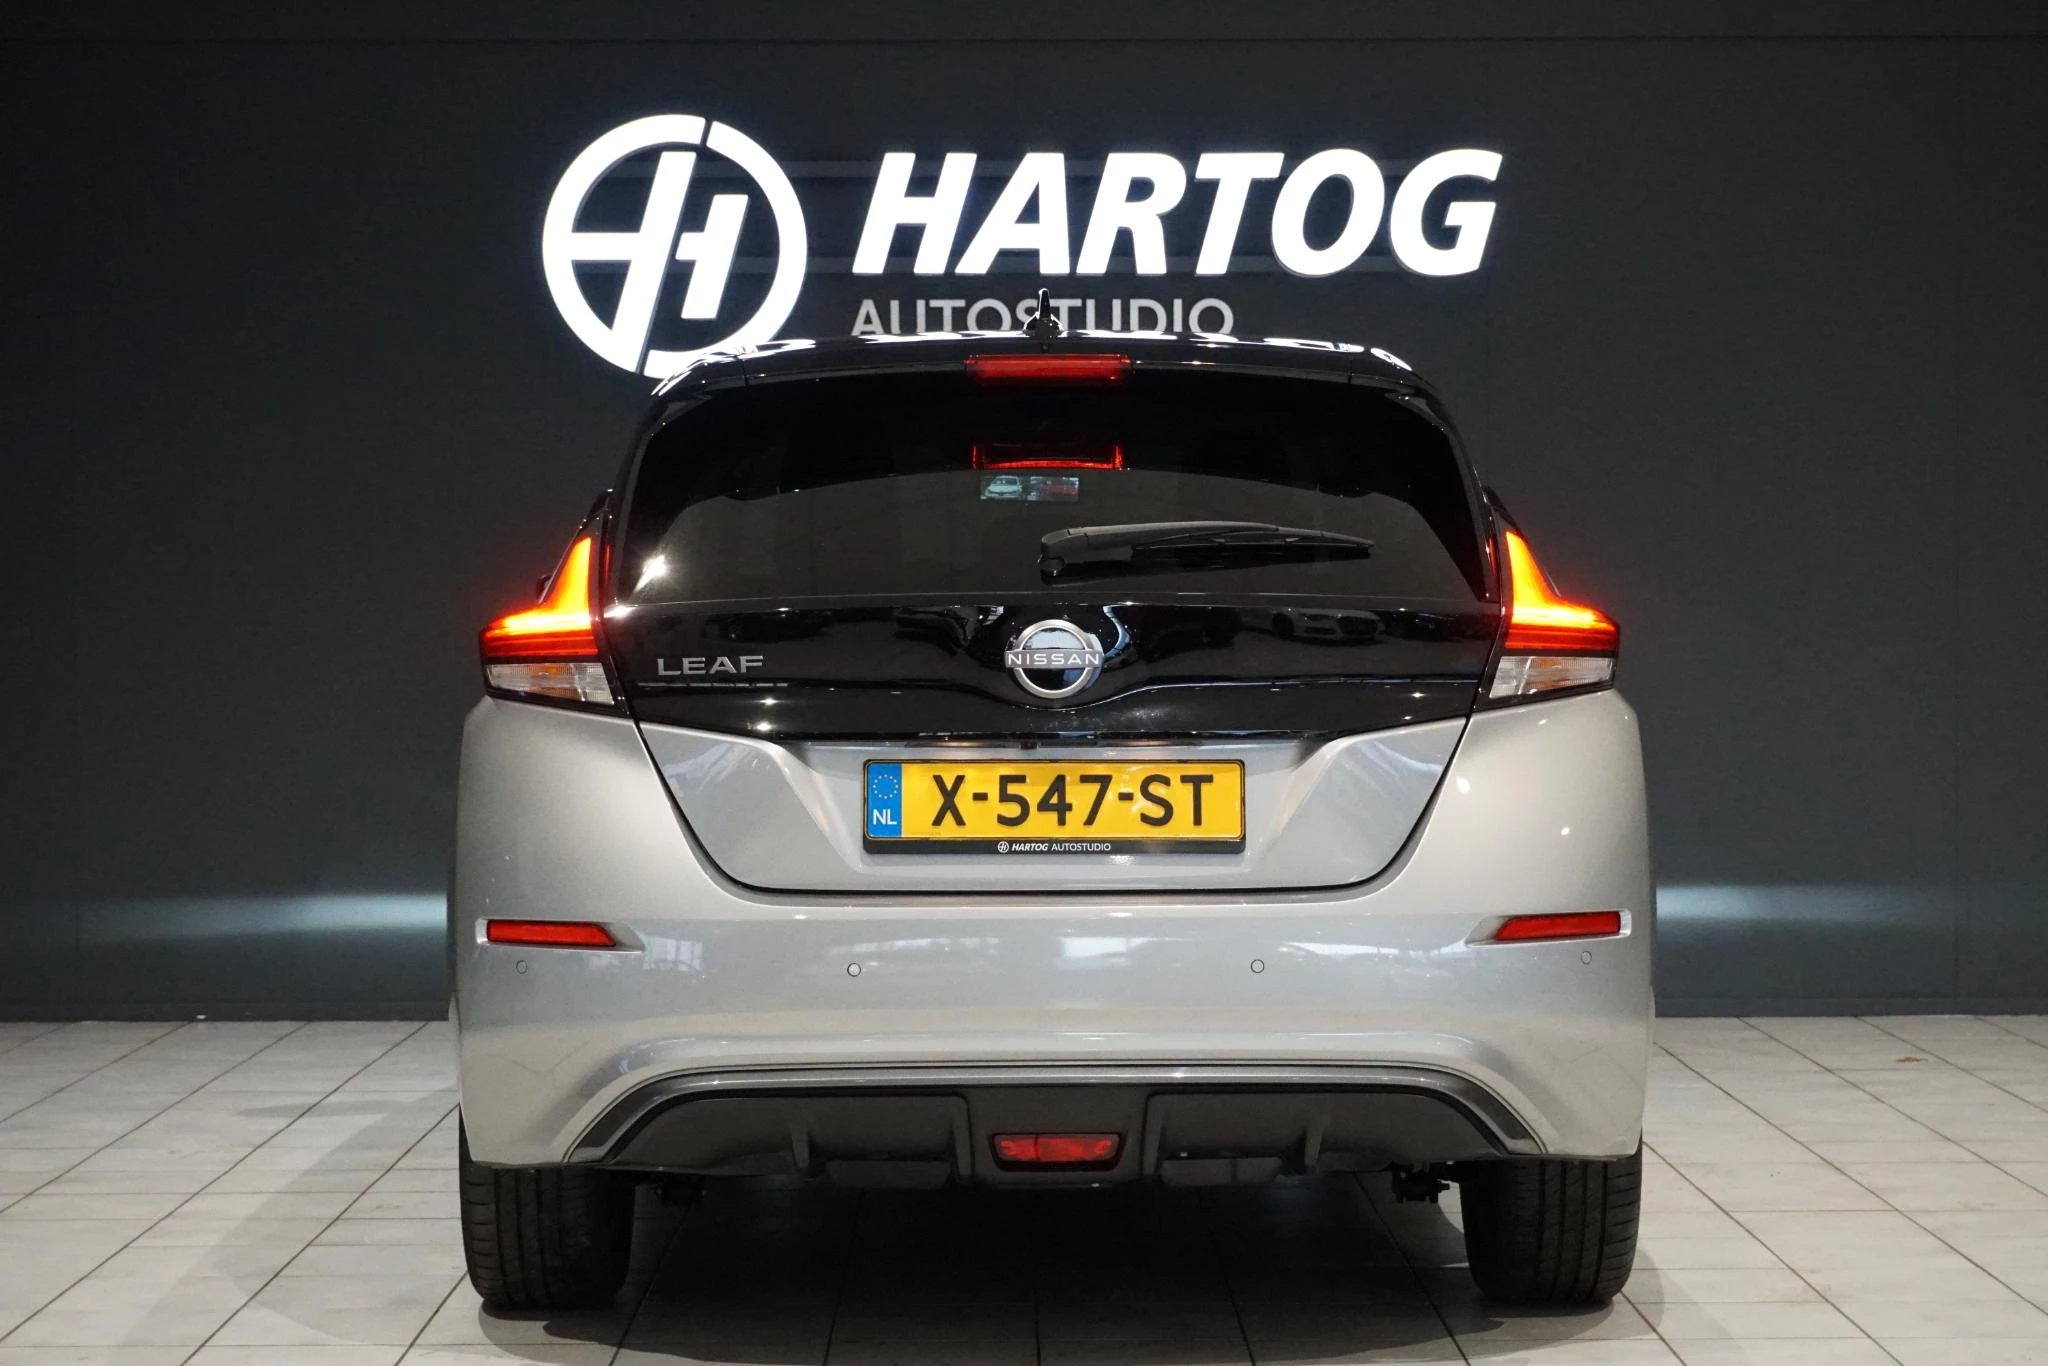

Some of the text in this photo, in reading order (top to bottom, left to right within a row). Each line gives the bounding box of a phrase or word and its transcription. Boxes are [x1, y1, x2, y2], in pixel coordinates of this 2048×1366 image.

[852, 148, 1504, 278] HARTOG
[850, 298, 1235, 336] AUTOSTUDIO
[656, 655, 764, 676] LEAF
[1007, 652, 1100, 667] NISSAN
[931, 773, 1214, 827] X-547-ST
[872, 808, 897, 826] NL
[1011, 843, 1049, 852] HARTOG
[1051, 843, 1112, 852] AUTOSTUDIO
